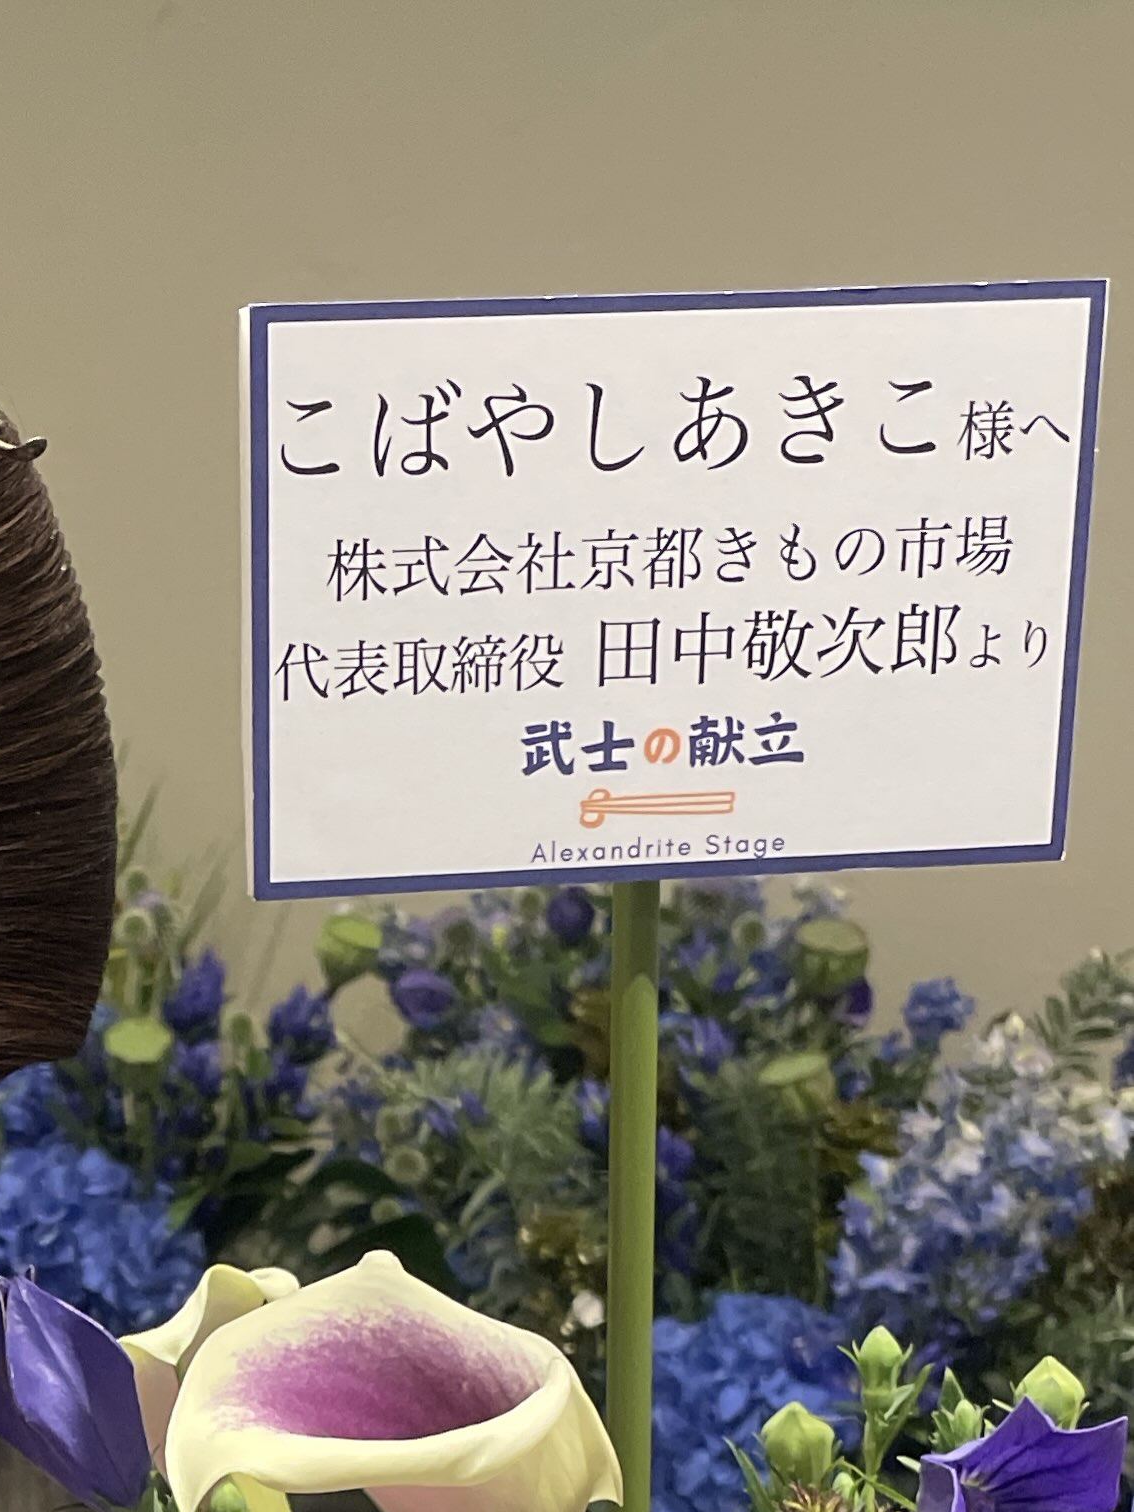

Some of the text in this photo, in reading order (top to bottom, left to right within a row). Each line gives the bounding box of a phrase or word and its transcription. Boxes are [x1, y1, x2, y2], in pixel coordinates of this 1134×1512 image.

[280, 375, 1071, 478] こばやしあきこ様へ
[326, 514, 1014, 602] 株式会社京都きもの市場
[274, 603, 1051, 702] 代表取締役 田中敬次郎より
[520, 711, 805, 776] 武士の献立
[531, 834, 786, 864] Alexandrite Stage
